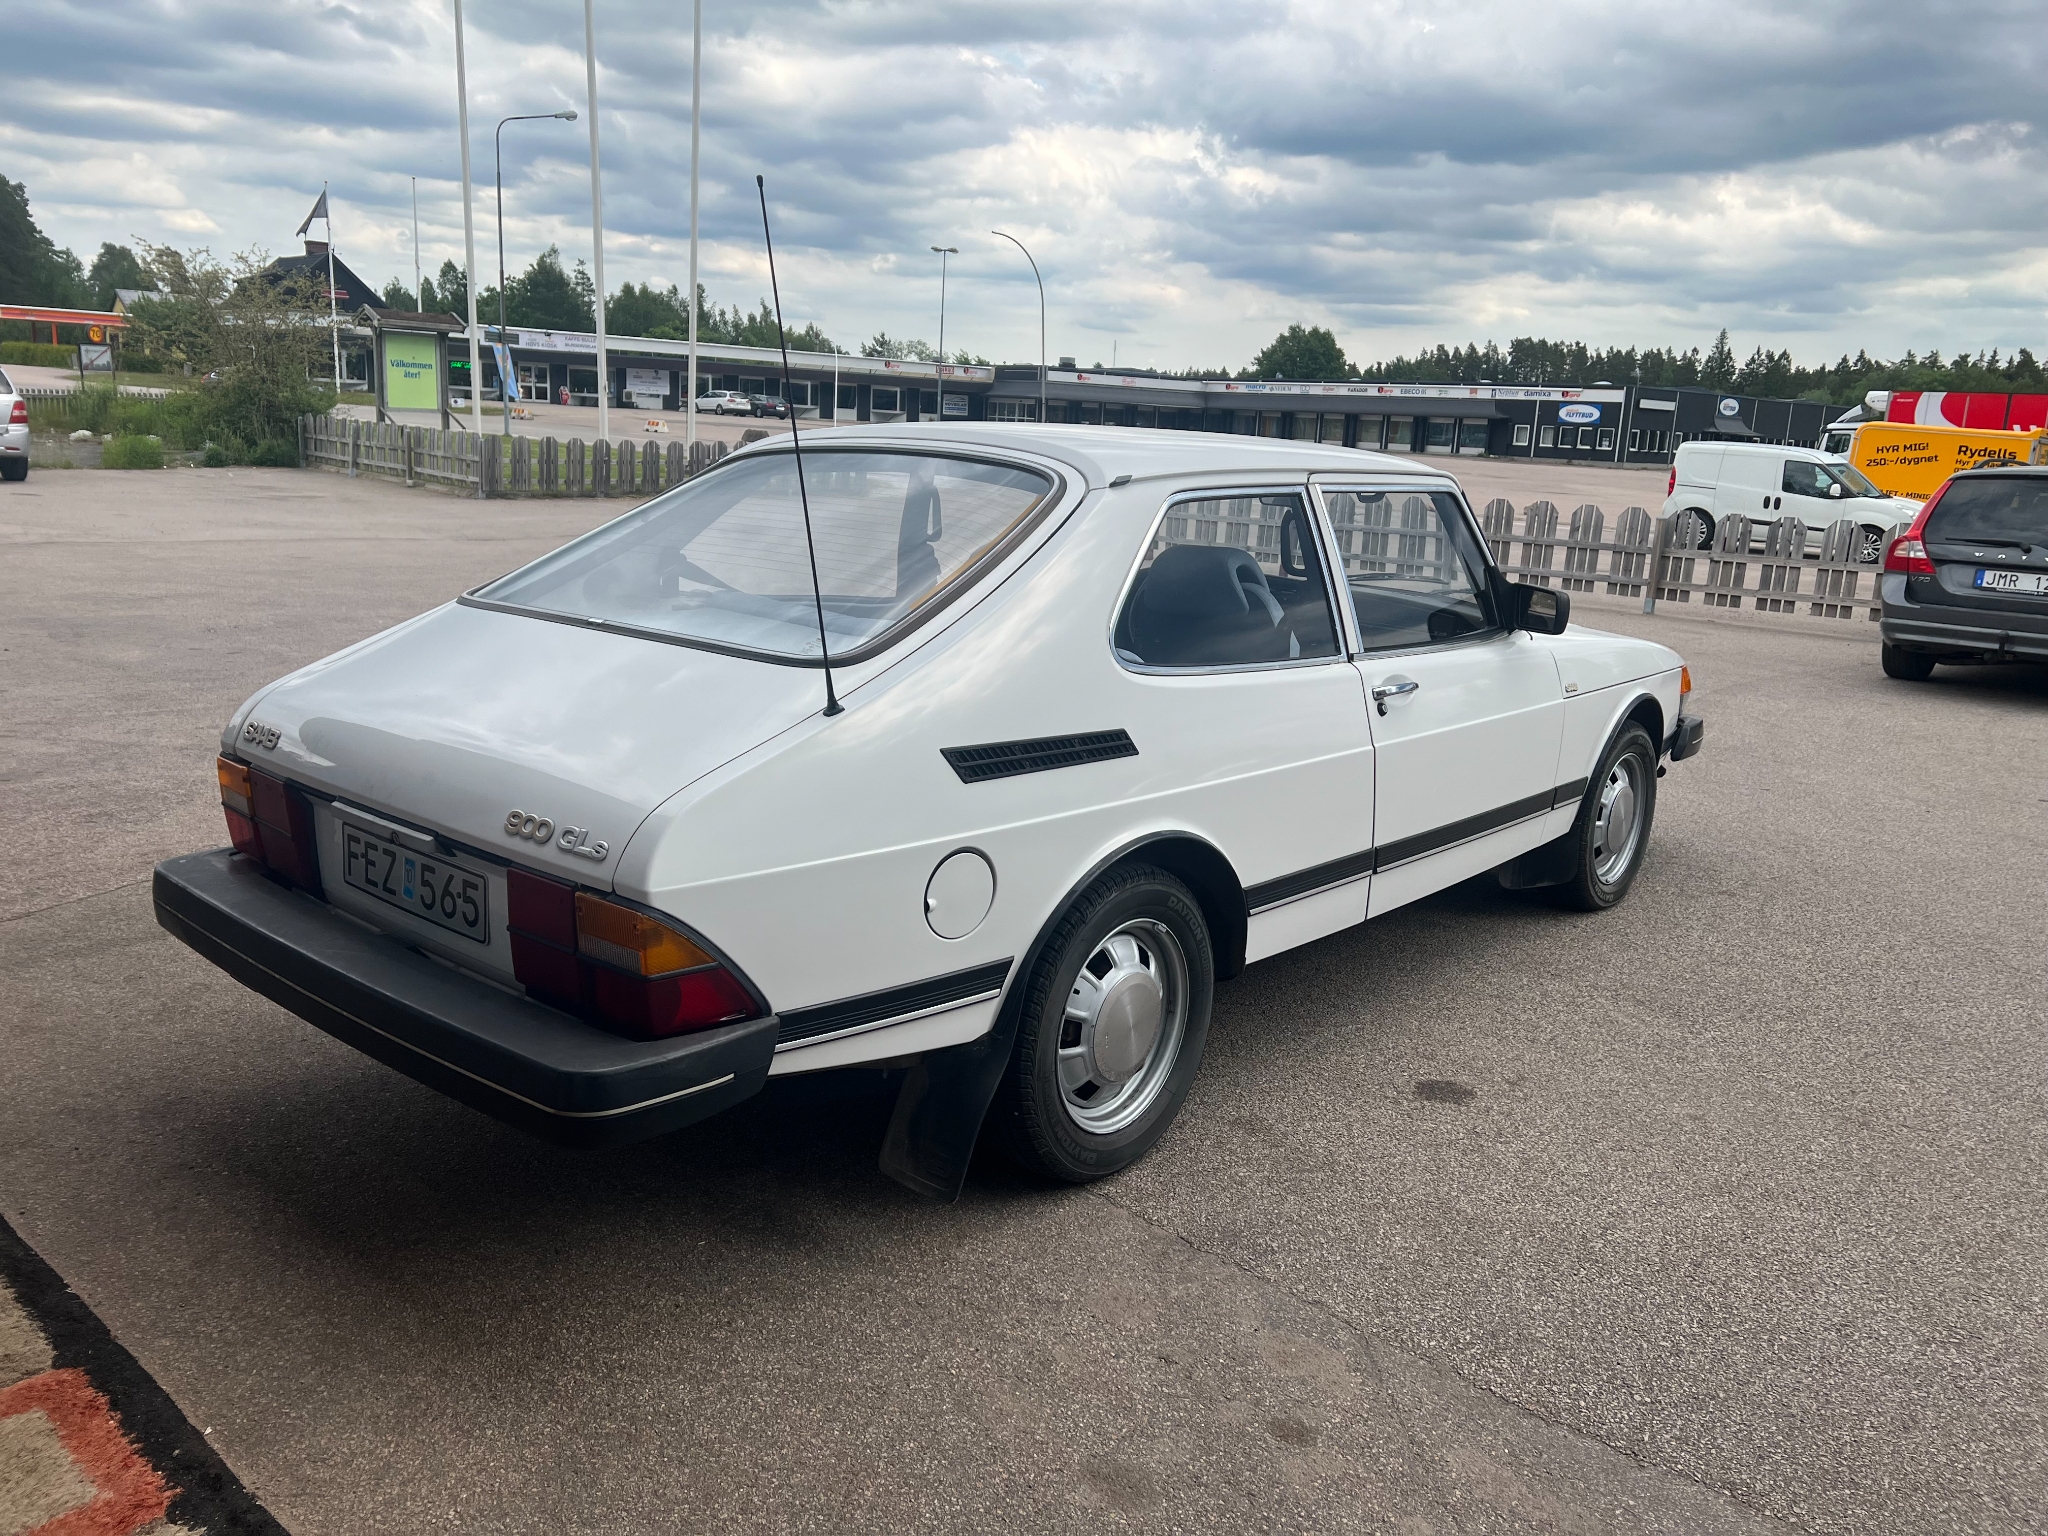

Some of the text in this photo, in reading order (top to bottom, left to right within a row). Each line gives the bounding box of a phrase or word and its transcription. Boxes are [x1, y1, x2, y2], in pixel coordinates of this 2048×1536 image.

[390, 359, 433, 370] Välkommen
[403, 370, 421, 379] åter!
[1876, 442, 1929, 454] HYR MIG!
[1957, 445, 2017, 460] Rydells
[1866, 454, 1939, 467] 250:-/dygnet
[1955, 458, 1971, 466] Hyr
[1911, 575, 1931, 583] V70
[1986, 572, 2019, 588] JMR
[243, 720, 281, 750] SAAB
[504, 808, 555, 845] 900
[346, 832, 397, 897] FEZ
[420, 862, 480, 928] 565
[1167, 896, 1204, 941] DAYTON
[1054, 1124, 1097, 1165] DAYTON
